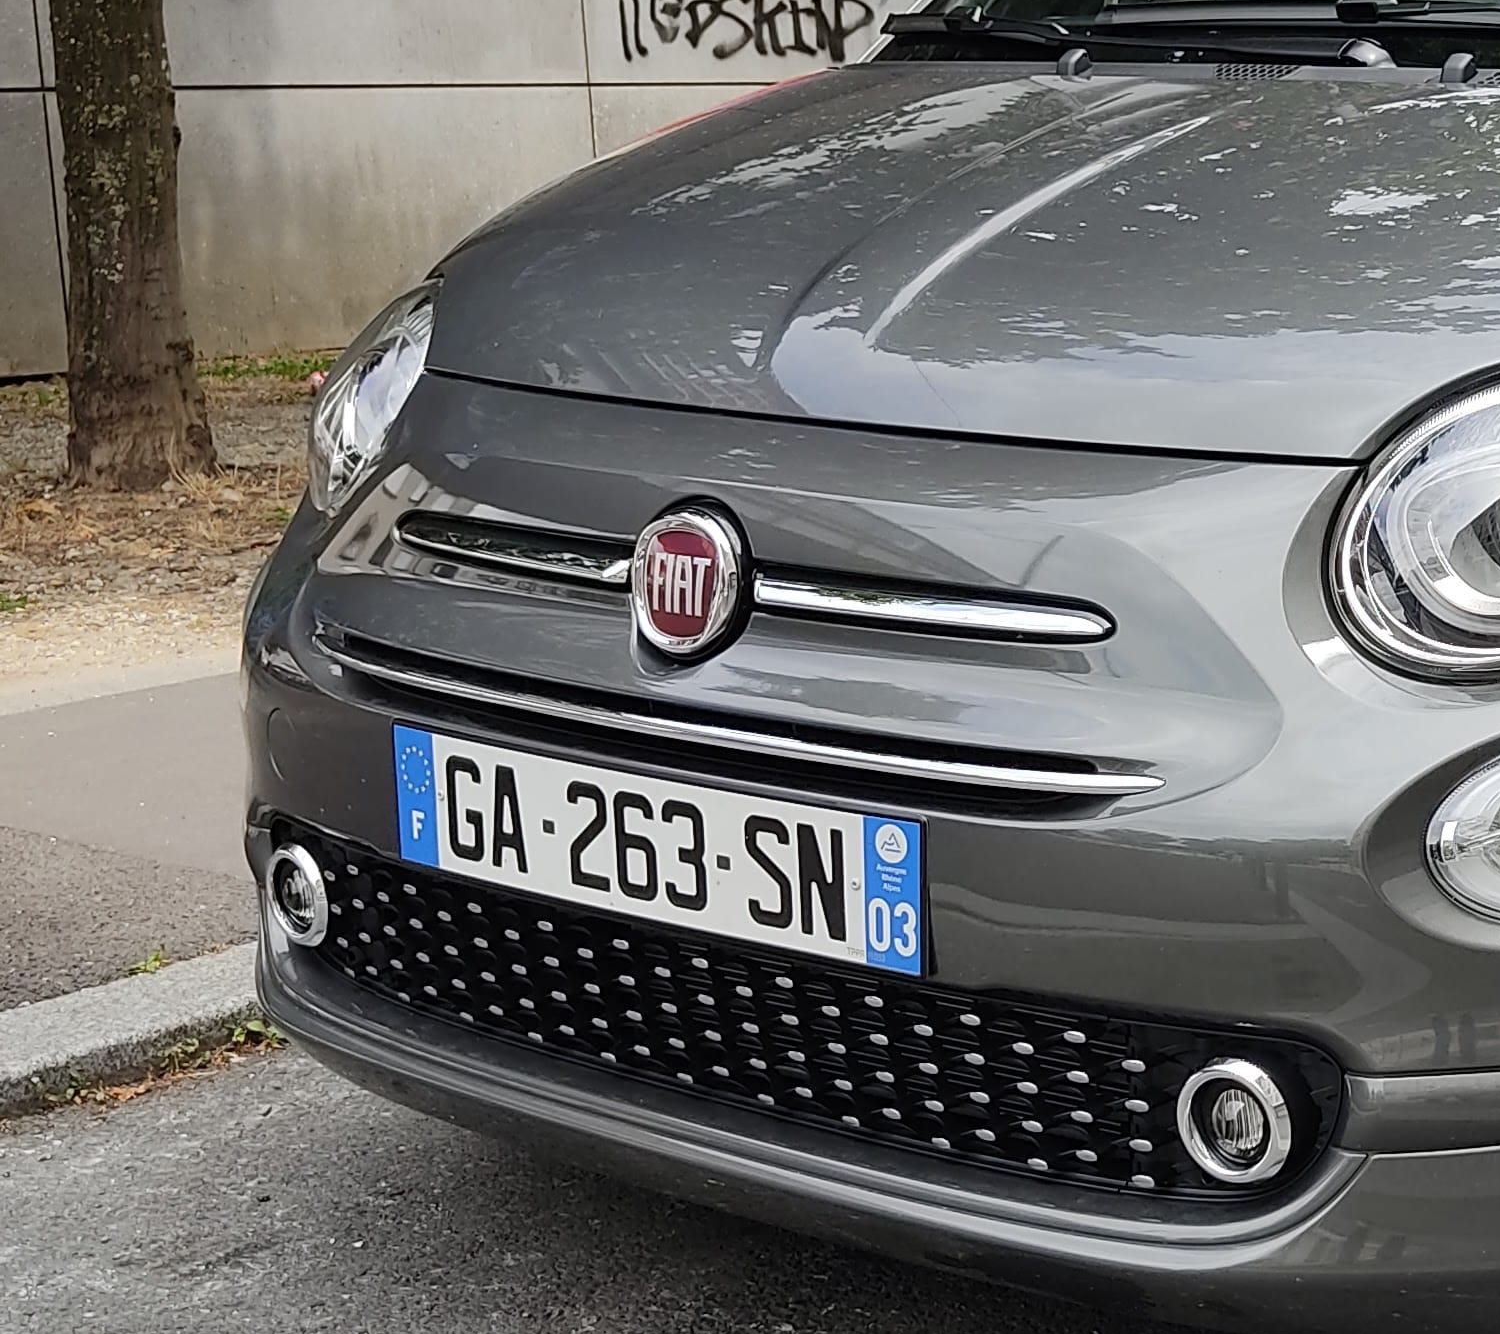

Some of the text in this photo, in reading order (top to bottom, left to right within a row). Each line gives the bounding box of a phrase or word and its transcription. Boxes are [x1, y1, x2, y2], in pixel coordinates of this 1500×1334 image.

[653, 552, 713, 618] FIAT
[412, 810, 425, 840] F
[445, 755, 847, 943] GA-263-SN
[868, 897, 917, 958] 03
